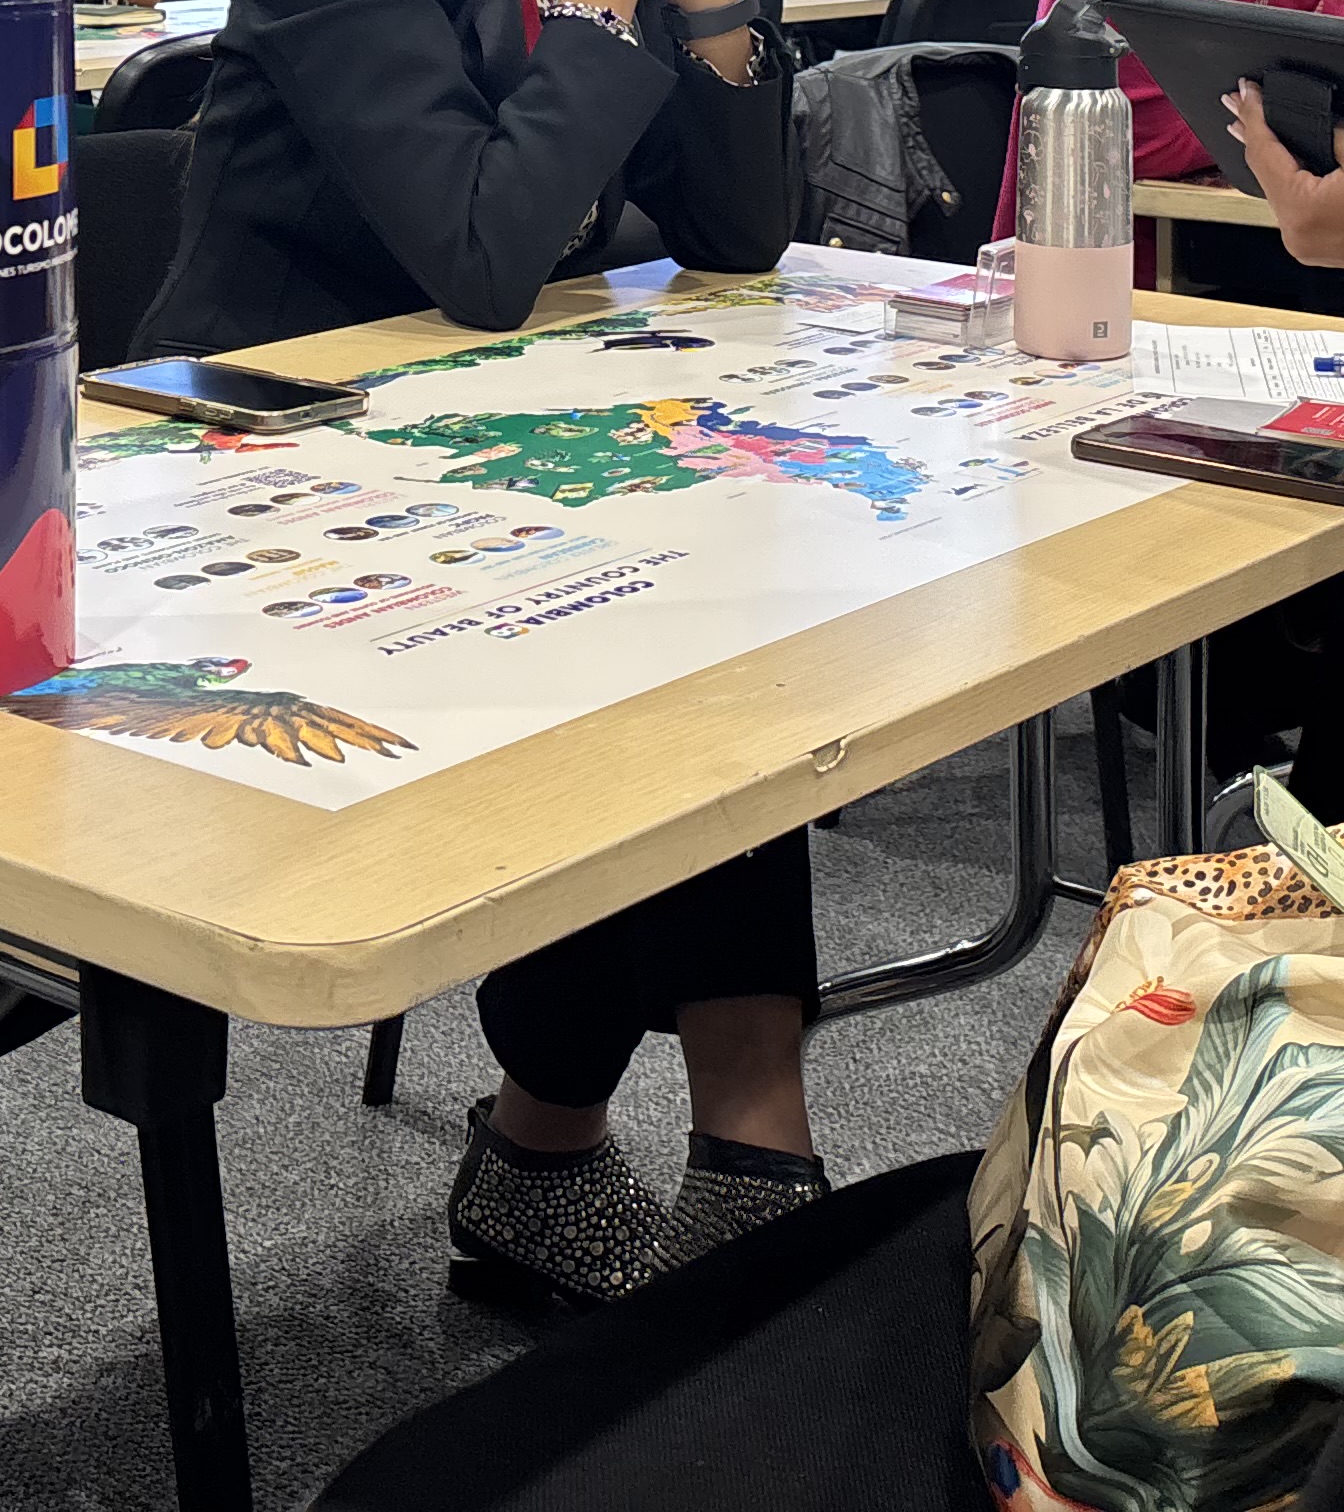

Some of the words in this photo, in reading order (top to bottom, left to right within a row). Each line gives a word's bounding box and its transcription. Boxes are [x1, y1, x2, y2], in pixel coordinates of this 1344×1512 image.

[1012, 415, 1097, 441] BELLEZA
[638, 549, 691, 567] THE
[525, 564, 641, 606] COUNTRY
[485, 605, 523, 620] OF
[515, 580, 655, 626] COLOMBIA
[377, 617, 484, 656] BEAUTY
